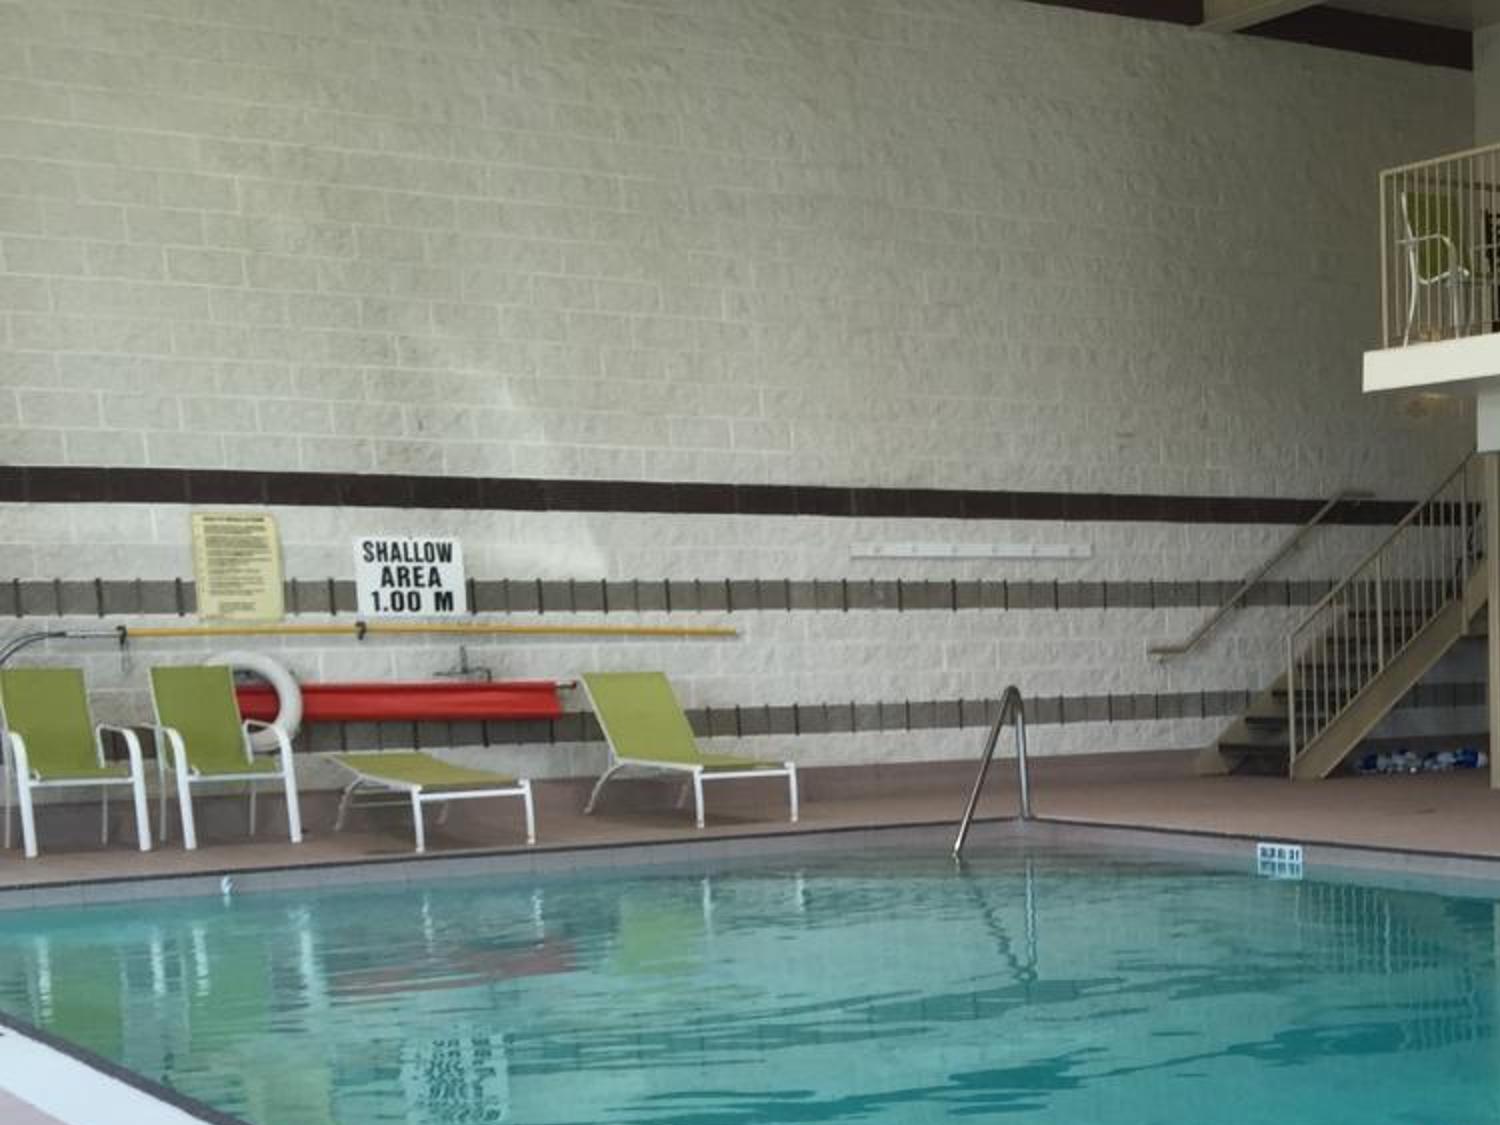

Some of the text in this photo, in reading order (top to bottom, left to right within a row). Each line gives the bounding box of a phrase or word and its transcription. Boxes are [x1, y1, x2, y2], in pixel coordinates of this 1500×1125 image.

[363, 541, 453, 562] SHALLOW
[381, 566, 442, 588] AREA
[372, 590, 454, 612] 1.00 M
